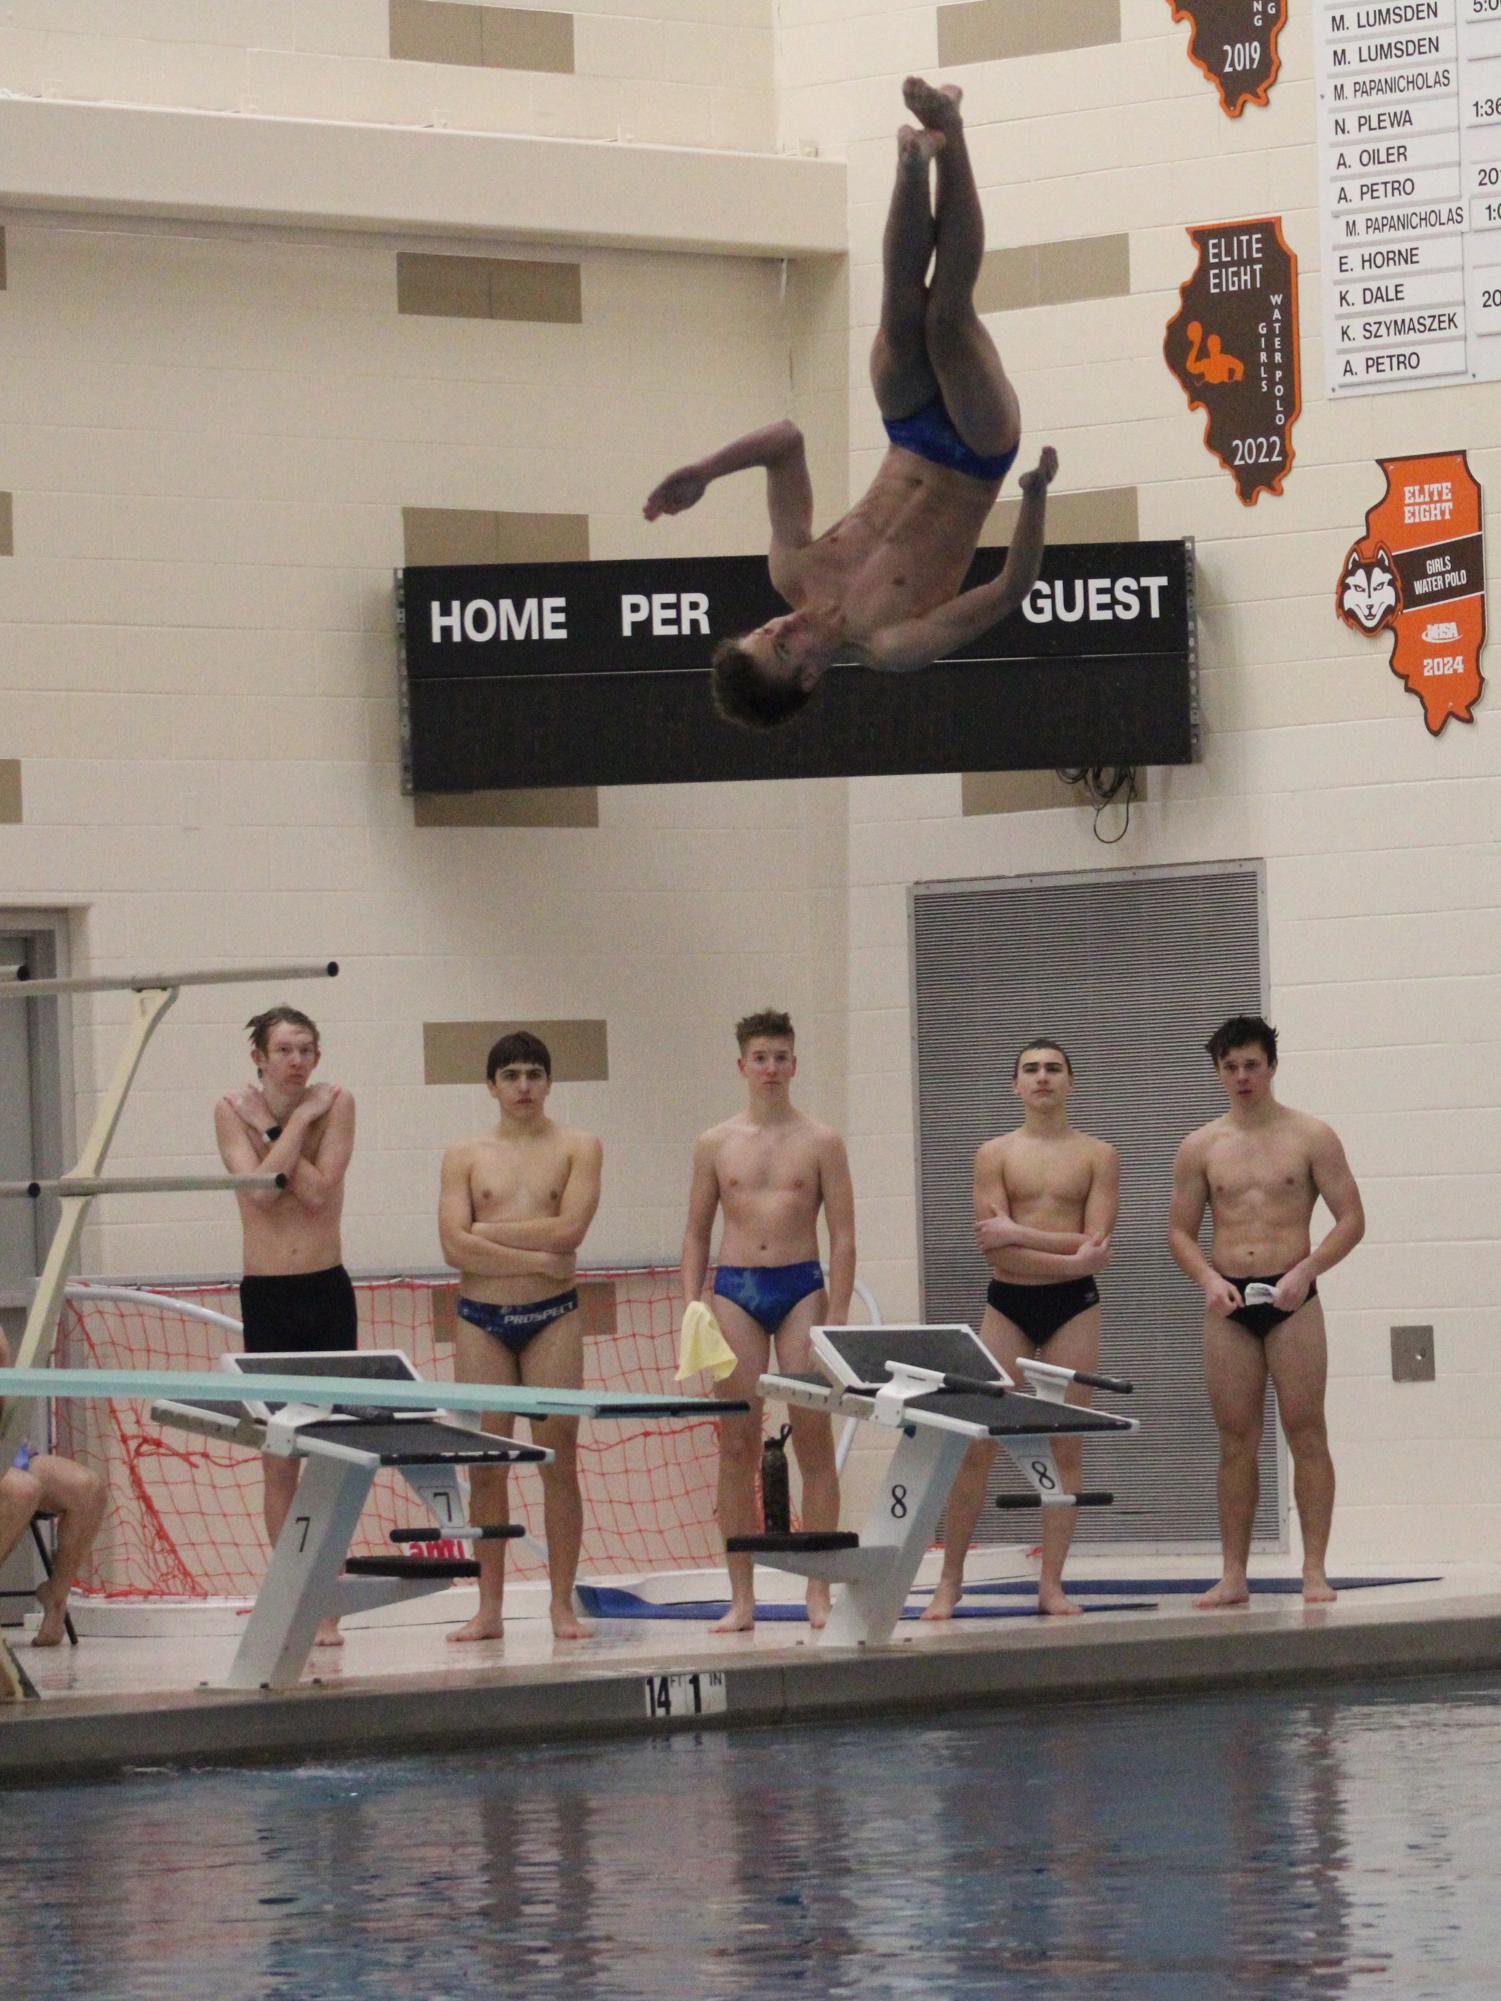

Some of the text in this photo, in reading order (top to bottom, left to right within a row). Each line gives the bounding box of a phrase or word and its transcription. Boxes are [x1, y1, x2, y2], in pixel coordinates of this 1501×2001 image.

[1331, 1, 1438, 32] M. LUMSDEN
[1473, 0, 1501, 13] 5:0
[1223, 41, 1261, 73] 2019
[1333, 36, 1440, 67] M. LUMSDEN
[1333, 69, 1450, 101] M. PAPANICHOLAS
[1334, 109, 1413, 136] N. PLEWA
[1336, 145, 1407, 170] A. OILER
[1337, 178, 1415, 204] A. PETRO
[1478, 167, 1501, 187] 20
[1345, 206, 1464, 237] M. PAPANICHOLAS
[1208, 233, 1263, 263] ELITE
[1339, 247, 1420, 273] E. HORNE
[1209, 263, 1263, 294] EIGHT
[1339, 283, 1405, 307] K. DALE
[1341, 312, 1458, 342] K. SZYMASZEK
[1258, 322, 1268, 392] GIRLS
[1270, 294, 1285, 425] WATER POLO
[1343, 351, 1420, 377] A. PETRO
[1232, 436, 1283, 466] 2022
[1403, 481, 1452, 504] ELITE
[1404, 501, 1453, 524] EIGHT
[1426, 555, 1452, 575] GIRLS
[1413, 569, 1467, 595] WATER POLO
[430, 576, 1169, 643] HOME PER GUEST
[1423, 655, 1465, 677] 2024
[503, 1301, 574, 1325] PROSPECT
[1031, 1460, 1056, 1490] 8
[432, 1492, 453, 1523] 7
[890, 1483, 908, 1519] 8
[296, 1516, 311, 1553] 7
[646, 1675, 671, 1717] 14
[689, 1673, 702, 1714] 1
[709, 1672, 722, 1687] IN
